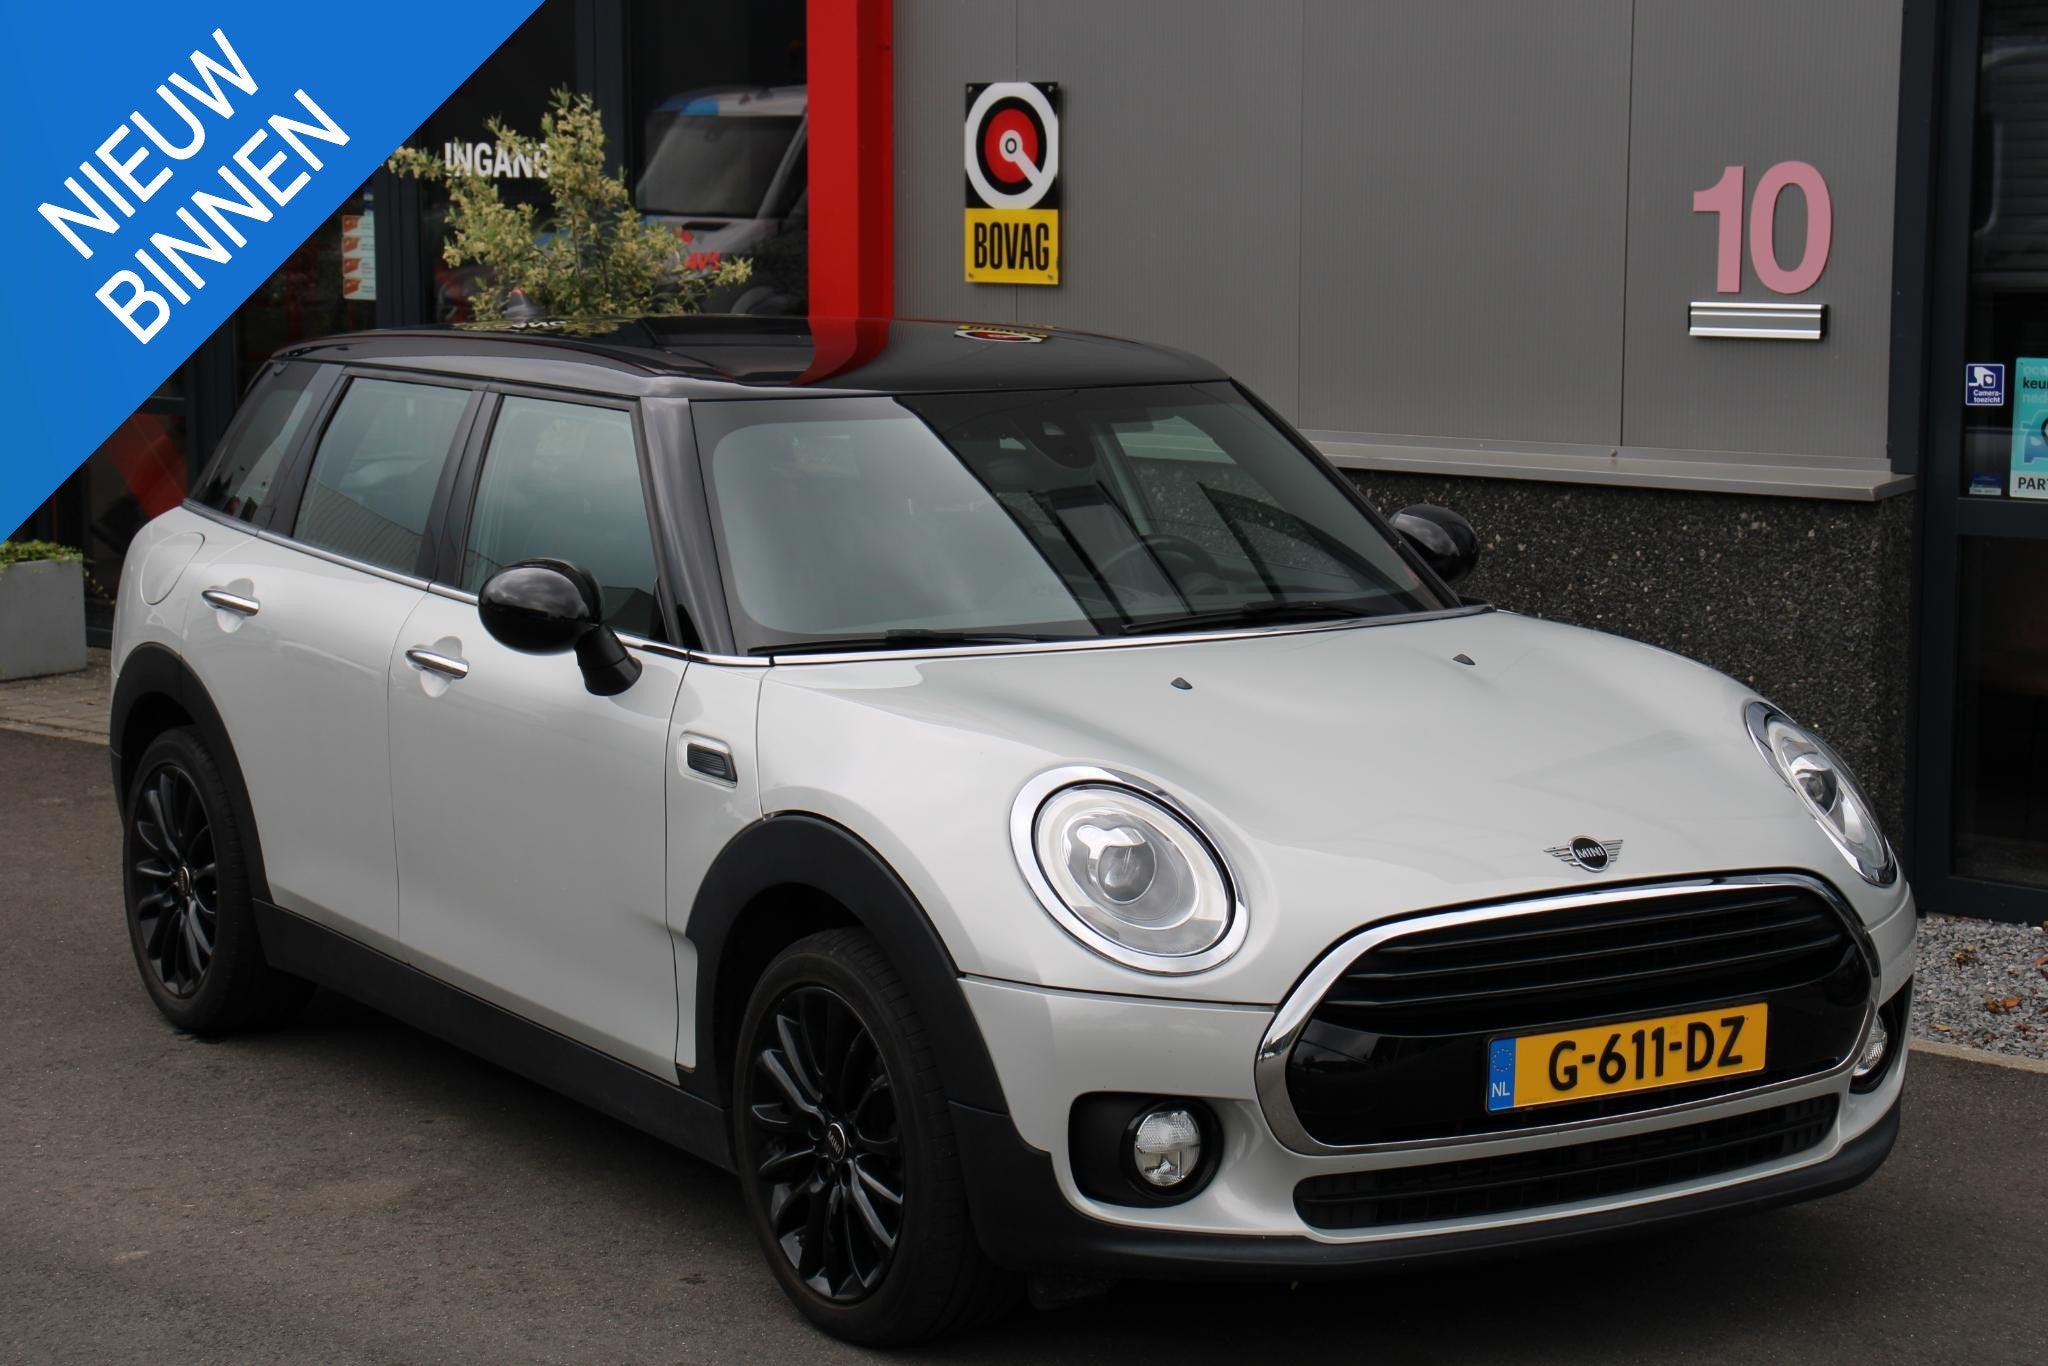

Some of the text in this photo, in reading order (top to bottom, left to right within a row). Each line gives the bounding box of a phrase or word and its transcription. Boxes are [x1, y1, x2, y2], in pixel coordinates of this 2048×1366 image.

[1693, 160, 1832, 294] 10
[973, 221, 1050, 271] BOVAG
[2023, 377, 2048, 389] keu
[2018, 477, 2048, 490] PAR
[1575, 846, 1605, 858] MINI
[1549, 1014, 1746, 1092] G-611-DZ
[1491, 1081, 1511, 1098] NL
